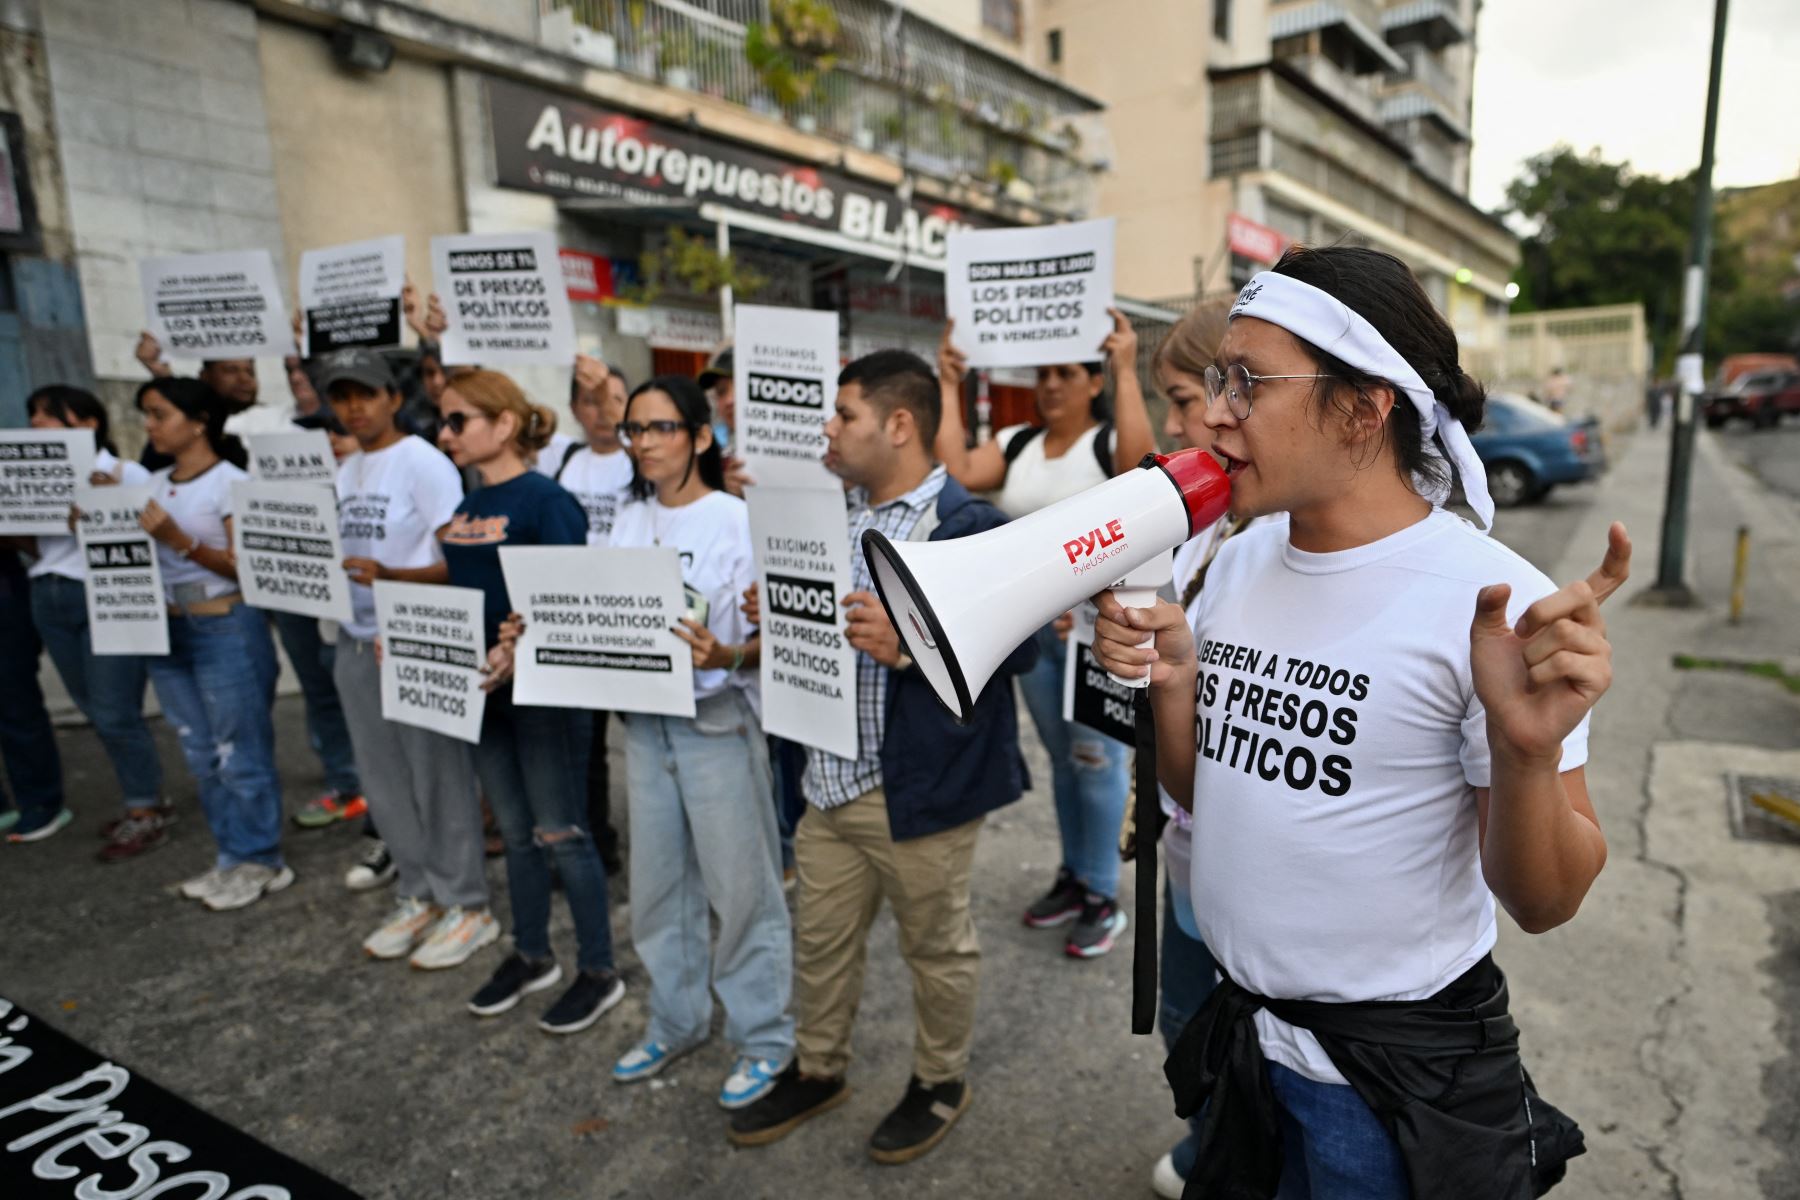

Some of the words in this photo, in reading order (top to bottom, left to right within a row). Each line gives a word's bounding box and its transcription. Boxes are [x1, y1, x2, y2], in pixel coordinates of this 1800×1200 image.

[526, 105, 834, 220] Autorepuestos
[839, 193, 976, 259] BLAC
[970, 265, 1001, 280] SON
[1039, 260, 1057, 275] DE
[454, 280, 475, 297] DE
[480, 276, 546, 295] PRESOS
[972, 285, 1009, 303] LOS
[1015, 279, 1085, 300] PRESOS
[459, 296, 550, 318] POLÍTICOS
[973, 300, 1083, 325] POLÍTICOS
[164, 317, 195, 332] LOS
[198, 314, 262, 328] PRESOS
[979, 331, 997, 344] EN
[1003, 326, 1080, 343] VENEZUELA
[170, 328, 267, 348] POLÍTICOS
[486, 336, 549, 350] VENEZUELA
[750, 376, 823, 406] TODOS
[745, 406, 769, 422] LOS
[772, 408, 826, 427] PRESOS
[747, 423, 825, 447] POLÍTICOS
[4, 465, 75, 480] PRESOS
[766, 536, 828, 557] EXIGIMOS
[250, 556, 275, 573] LOS
[277, 558, 330, 580] PRESOS
[764, 555, 807, 572] LIBERTAD
[808, 560, 836, 574] PARA
[1072, 542, 1129, 577] PyleUSA.com
[255, 574, 332, 602] POLÍTICOS
[768, 582, 835, 617] TODOS
[583, 596, 592, 607] A
[594, 594, 635, 609] TODOS
[638, 596, 663, 609] LOS
[532, 609, 584, 626] PRESOS
[588, 611, 667, 630] POLÍTICOS!
[576, 633, 589, 645] LA
[768, 619, 790, 640] LOS
[792, 624, 842, 650] PRESOS
[773, 645, 841, 678] POLÍTICOS
[396, 663, 420, 684] LOS
[423, 667, 470, 693] PRESOS
[772, 669, 786, 684] EN
[787, 673, 843, 700] VENEZUELA
[1262, 654, 1278, 680] A
[1284, 657, 1371, 702] TODOS
[398, 684, 468, 717] POLÍTICOS
[1195, 670, 1220, 709] OS
[1225, 678, 1358, 746] PRESOS
